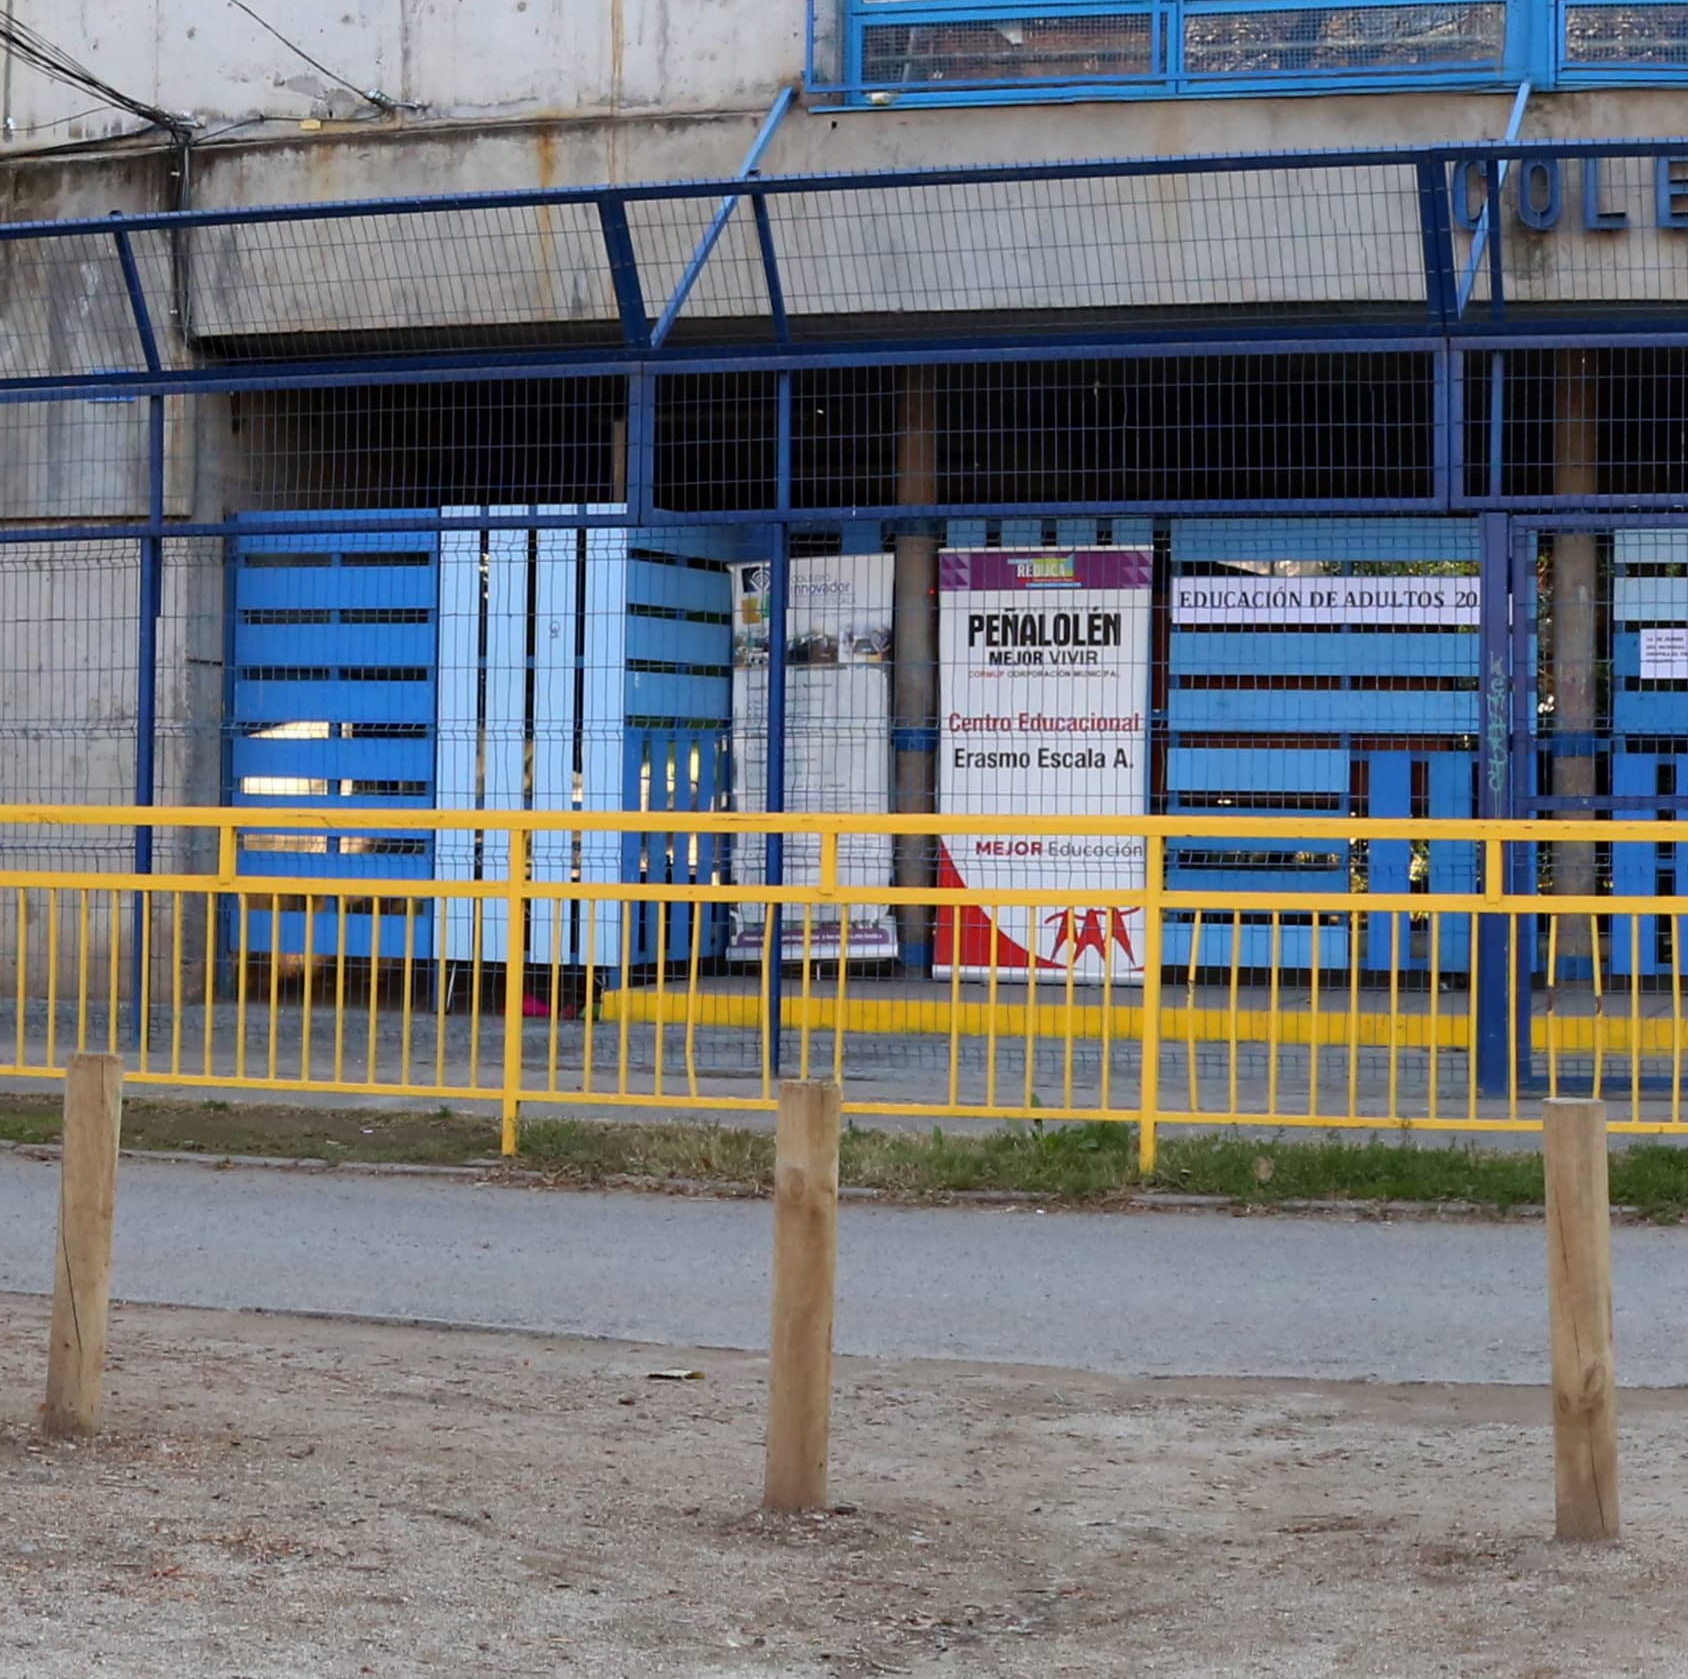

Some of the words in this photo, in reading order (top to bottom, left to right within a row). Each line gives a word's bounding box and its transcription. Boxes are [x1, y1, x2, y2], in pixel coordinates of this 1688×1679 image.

[1179, 586, 1302, 609] EDUCACIÓN
[1309, 591, 1339, 609] DE
[1344, 591, 1446, 609] ADULTOS
[968, 605, 1122, 647] PEÑALOLÉN
[989, 650, 1044, 666] MEJOR
[1048, 650, 1098, 666] VIVIR
[949, 713, 1012, 733] Centro
[1018, 712, 1140, 733] Educacional
[954, 748, 1031, 769] Erasmo
[1037, 747, 1106, 769] Escala
[1112, 748, 1134, 769] A.
[976, 841, 1043, 857] MEJOR
[1048, 841, 1144, 858] Educación
